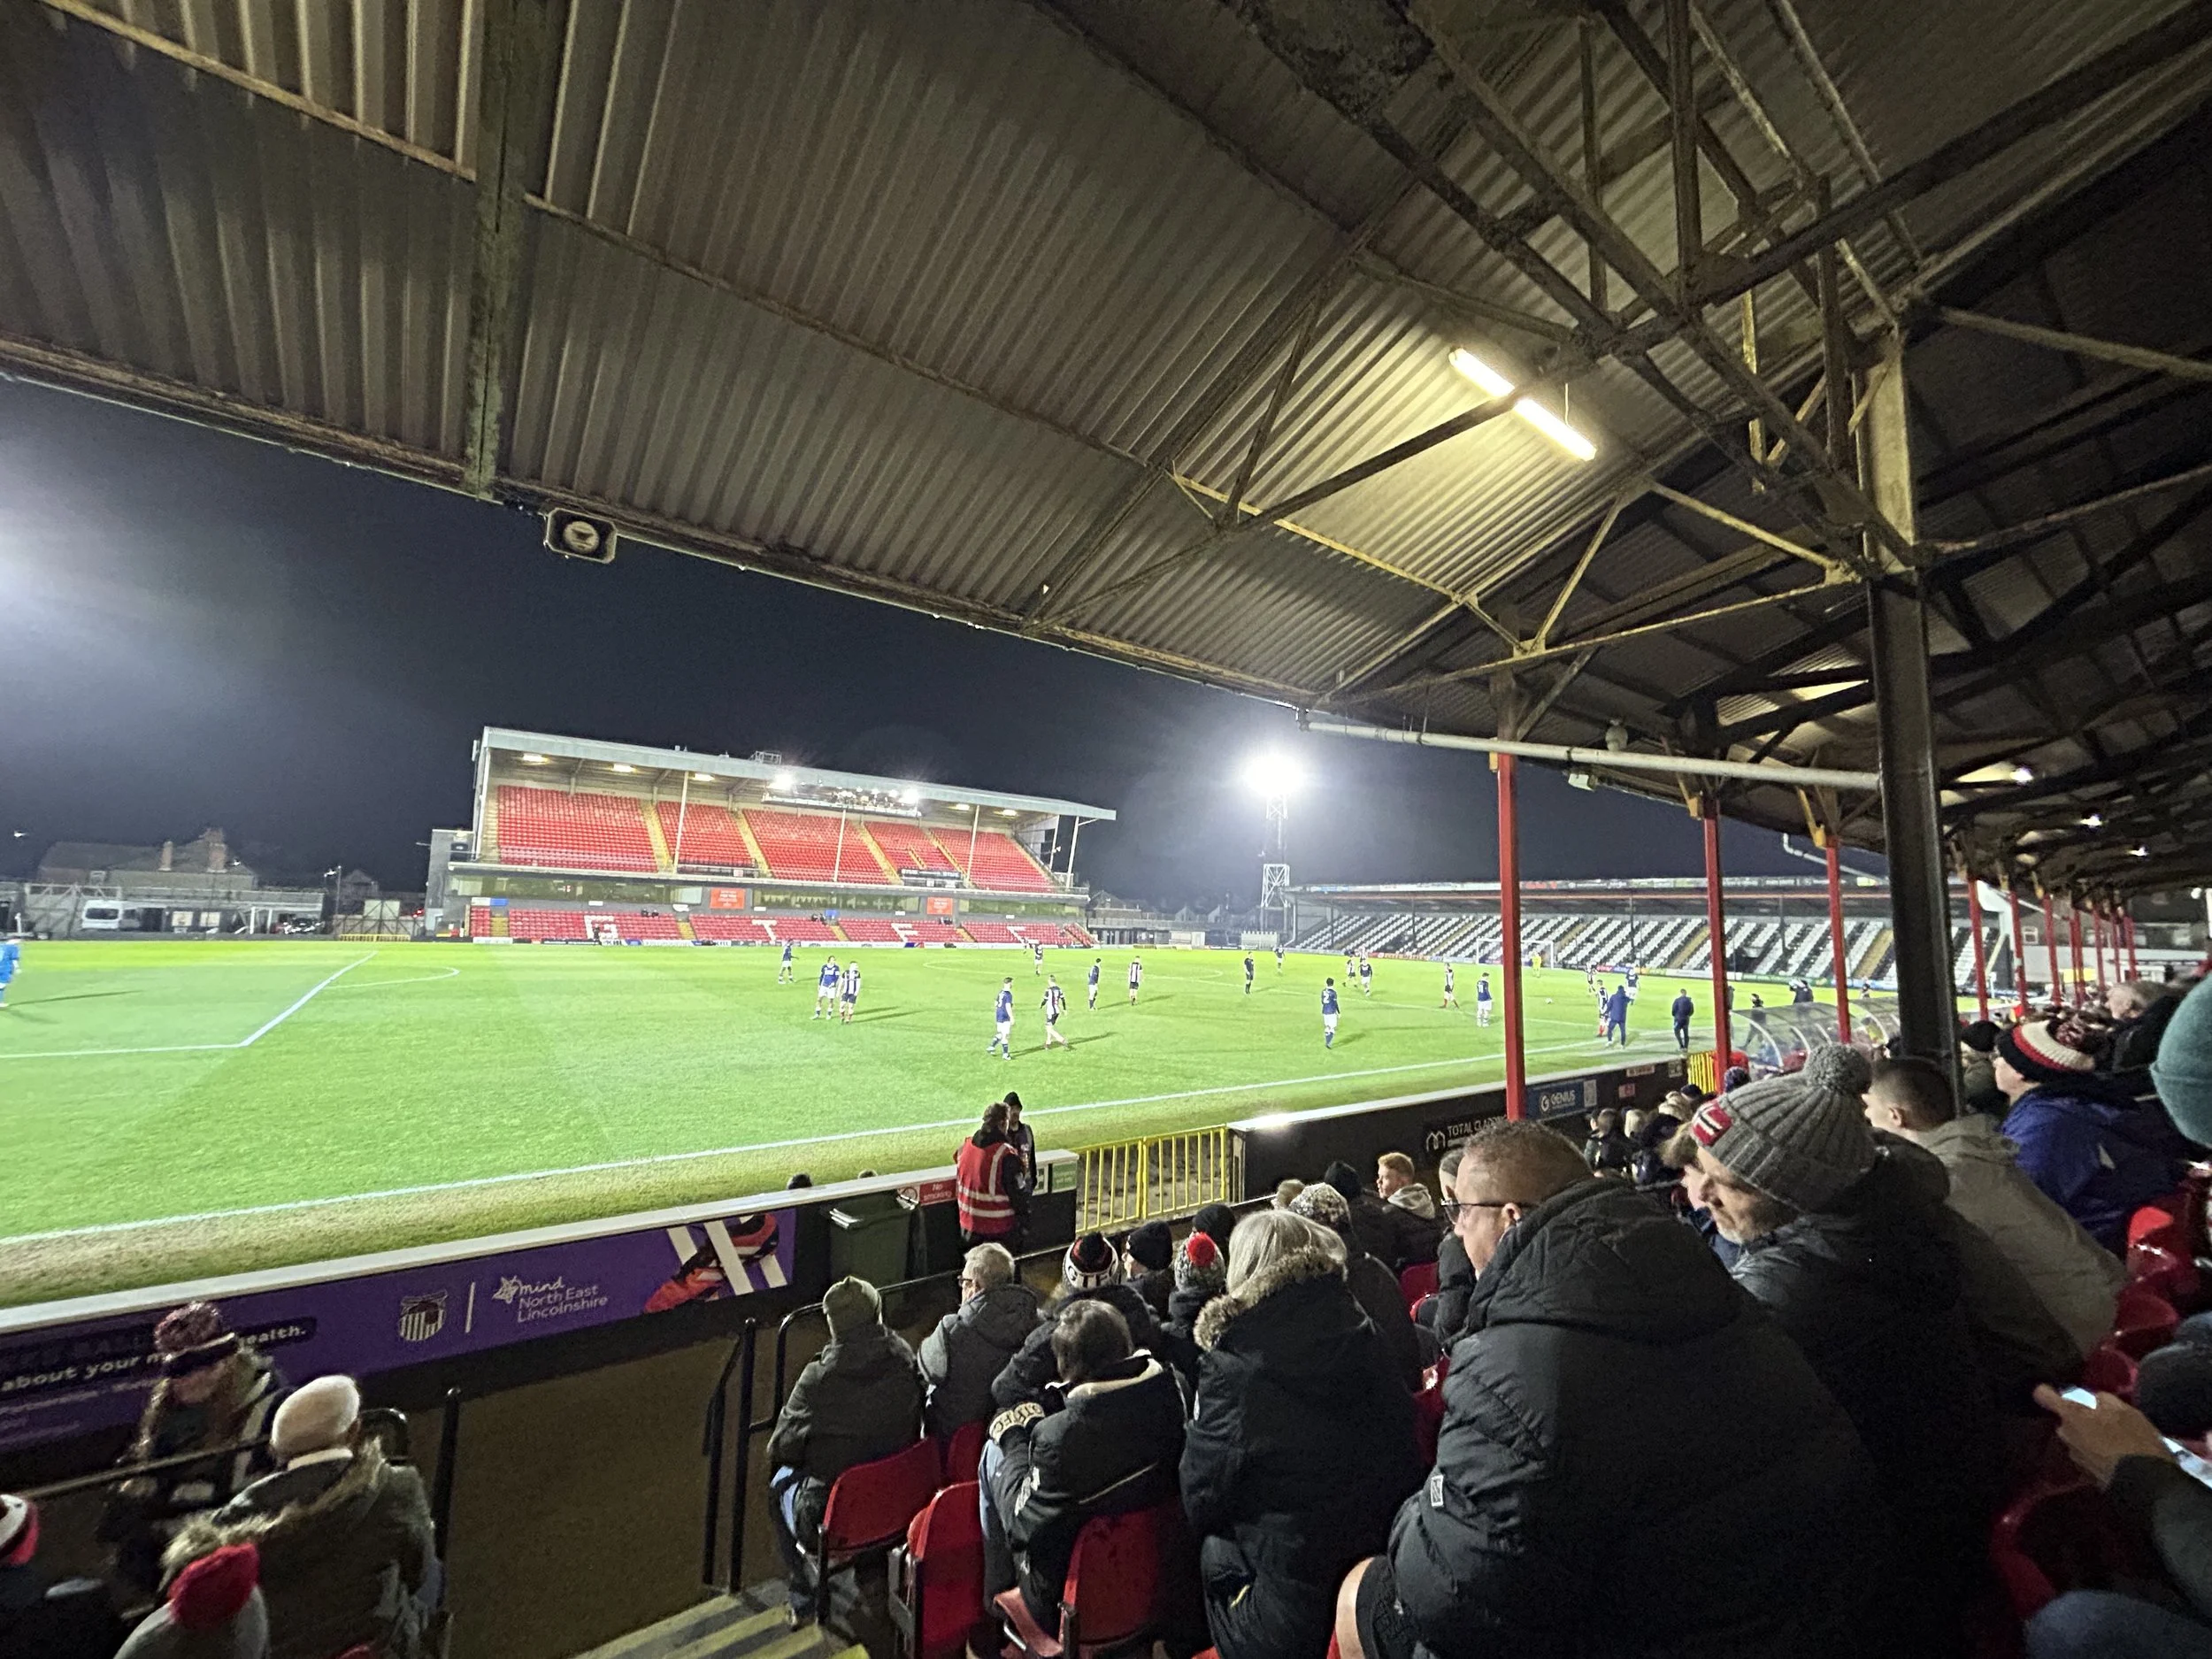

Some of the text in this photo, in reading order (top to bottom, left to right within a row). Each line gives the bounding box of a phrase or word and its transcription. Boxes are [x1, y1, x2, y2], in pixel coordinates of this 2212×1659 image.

[1550, 1089, 1576, 1105] GENIUS
[1447, 1121, 1473, 1138] TOTAL
[519, 1276, 565, 1294] mind
[519, 1286, 599, 1310] North East
[518, 1296, 609, 1323] Lincolnshire
[1, 1367, 77, 1392] about
[84, 1355, 140, 1379] your
